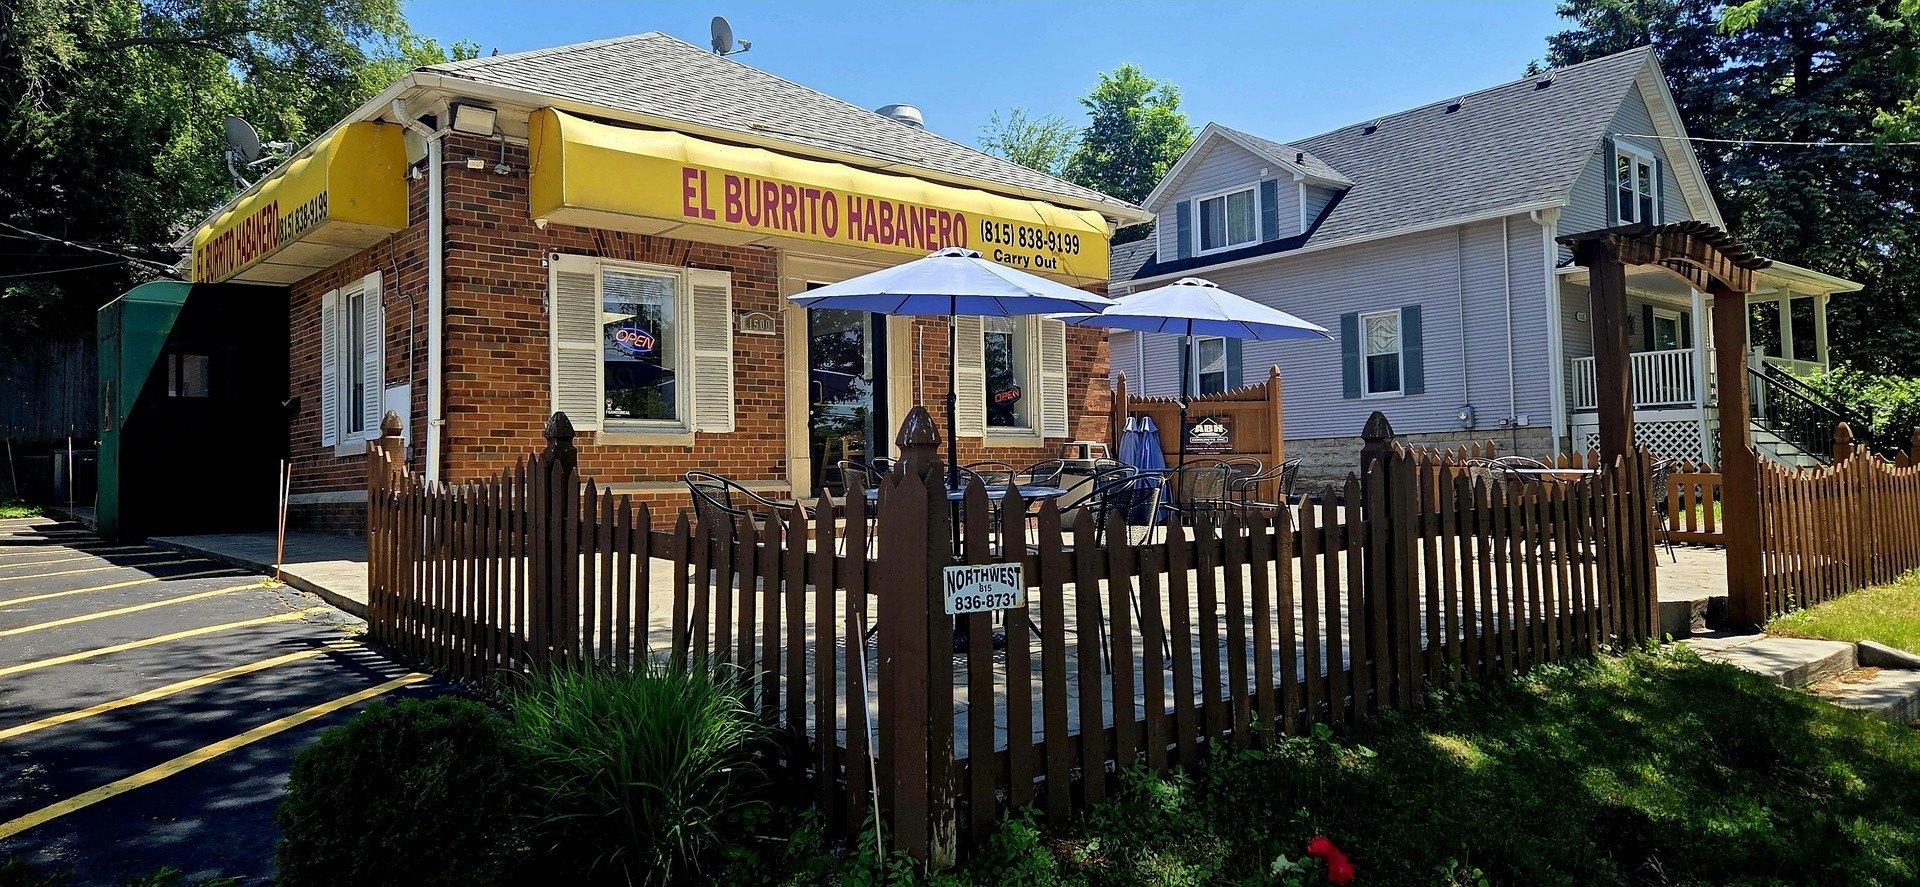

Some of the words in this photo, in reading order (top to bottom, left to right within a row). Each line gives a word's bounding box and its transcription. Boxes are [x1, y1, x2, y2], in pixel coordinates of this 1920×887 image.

[295, 189, 328, 235] 838-9199
[682, 166, 716, 220] EL
[724, 174, 839, 238] BURRITO
[847, 195, 968, 251] HABANERO
[206, 227, 234, 283] BURRITO
[237, 199, 279, 268] HABANERO
[980, 218, 1015, 248] (815)
[1018, 226, 1080, 256] 838-9199
[993, 248, 1030, 270] Carry
[1034, 254, 1058, 270] Out
[749, 318, 771, 331] 1500
[615, 329, 655, 350] OPEN
[994, 388, 1020, 403] OPEN
[946, 566, 1021, 598] NORTHWEST
[978, 584, 992, 593] 815
[954, 592, 1017, 611] 836-8731
